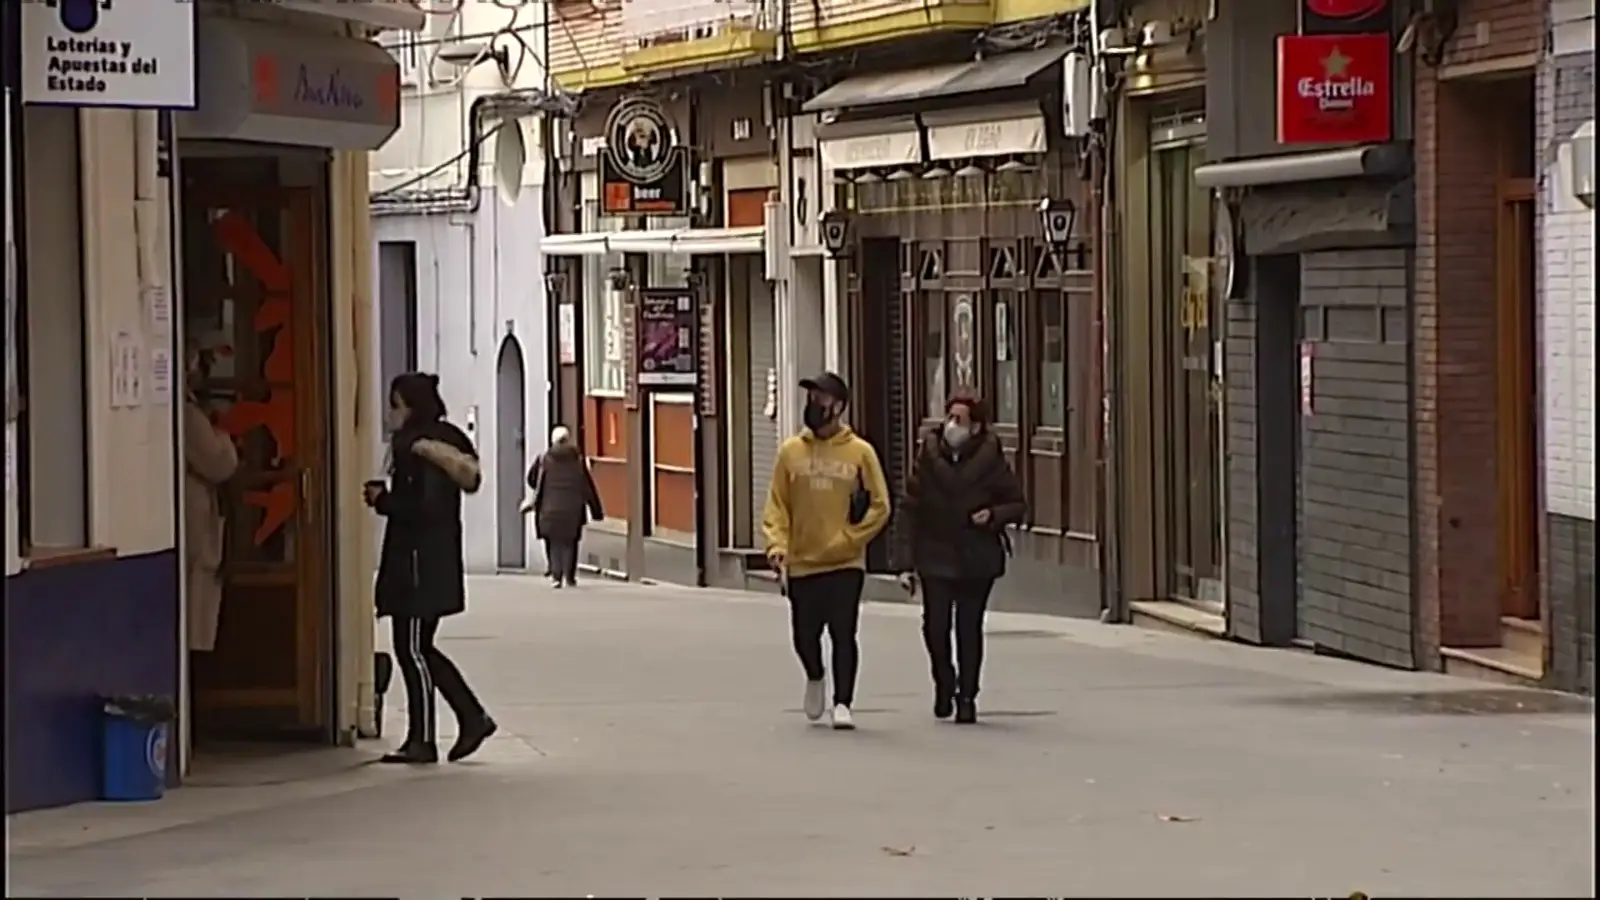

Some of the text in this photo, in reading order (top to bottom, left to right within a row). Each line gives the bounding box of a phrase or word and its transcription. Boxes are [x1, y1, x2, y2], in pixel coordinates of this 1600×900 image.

[47, 36, 131, 58] Loterías y
[48, 57, 157, 75] Apuestas del
[47, 76, 106, 92] Estado
[1298, 76, 1375, 98] Estrella
[634, 185, 661, 200] beer
